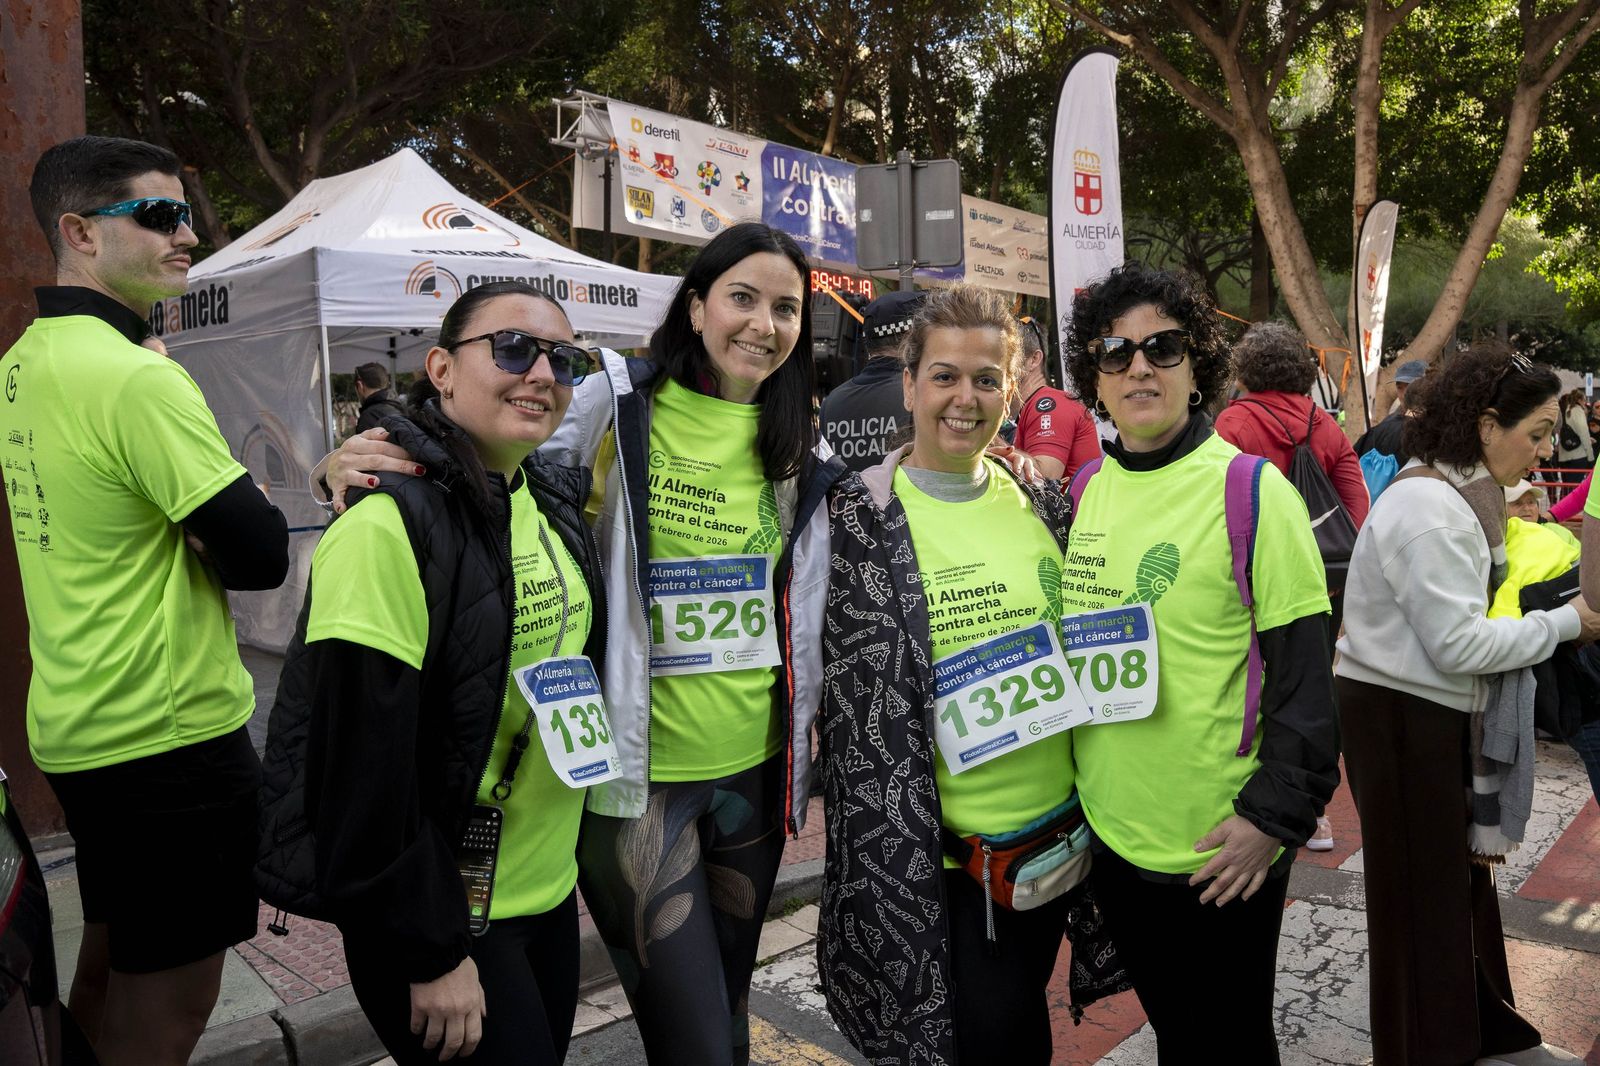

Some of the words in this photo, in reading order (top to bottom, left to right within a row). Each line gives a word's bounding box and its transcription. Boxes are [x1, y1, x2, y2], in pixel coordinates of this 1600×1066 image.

[644, 122, 681, 142] deretil
[773, 156, 786, 180] II
[1063, 222, 1121, 239] ALMERÍA
[1075, 240, 1105, 250] CIUDAD
[149, 283, 229, 337] olameta
[826, 416, 898, 440] POLICIA
[832, 437, 889, 459] LOCAL
[662, 478, 726, 504] Almería
[665, 495, 716, 516] marcha
[648, 507, 685, 524] ontra
[688, 515, 701, 527] el
[704, 519, 748, 535] cáncer
[658, 525, 692, 540] febrero
[693, 534, 704, 543] de
[706, 536, 728, 546] 2026
[649, 566, 697, 578] Almería
[717, 561, 755, 574] marcha
[1069, 551, 1106, 568] Almería
[689, 579, 701, 589] el
[704, 577, 743, 589] cáncer
[1066, 568, 1096, 581] marcha
[940, 580, 1008, 604] Almería
[1076, 581, 1085, 593] el
[1087, 584, 1123, 598] cáncer
[555, 609, 562, 623] el
[566, 600, 585, 617] ncer
[929, 609, 945, 620] en
[948, 598, 1001, 616] marcha
[1088, 601, 1105, 609] 2026
[650, 598, 767, 644] 1526
[930, 617, 974, 633] contra
[978, 612, 990, 623] el
[994, 606, 1037, 621] cáncer
[1062, 621, 1081, 632] ería
[1082, 622, 1094, 630] en
[1097, 615, 1135, 627] marcha
[522, 641, 533, 650] de
[536, 631, 558, 644] febrer
[940, 637, 950, 646] de
[953, 630, 985, 643] febrero
[1074, 633, 1083, 644] el
[1086, 630, 1121, 643] cáncer
[934, 653, 978, 679] Almería
[978, 650, 993, 661] en
[995, 633, 1036, 655] marcha
[936, 672, 973, 692] contra
[974, 665, 986, 675] el
[987, 650, 1023, 671] cáncer
[543, 682, 570, 696] contra
[570, 679, 577, 690] el
[939, 664, 1066, 739] 1329
[550, 702, 613, 754] 133
